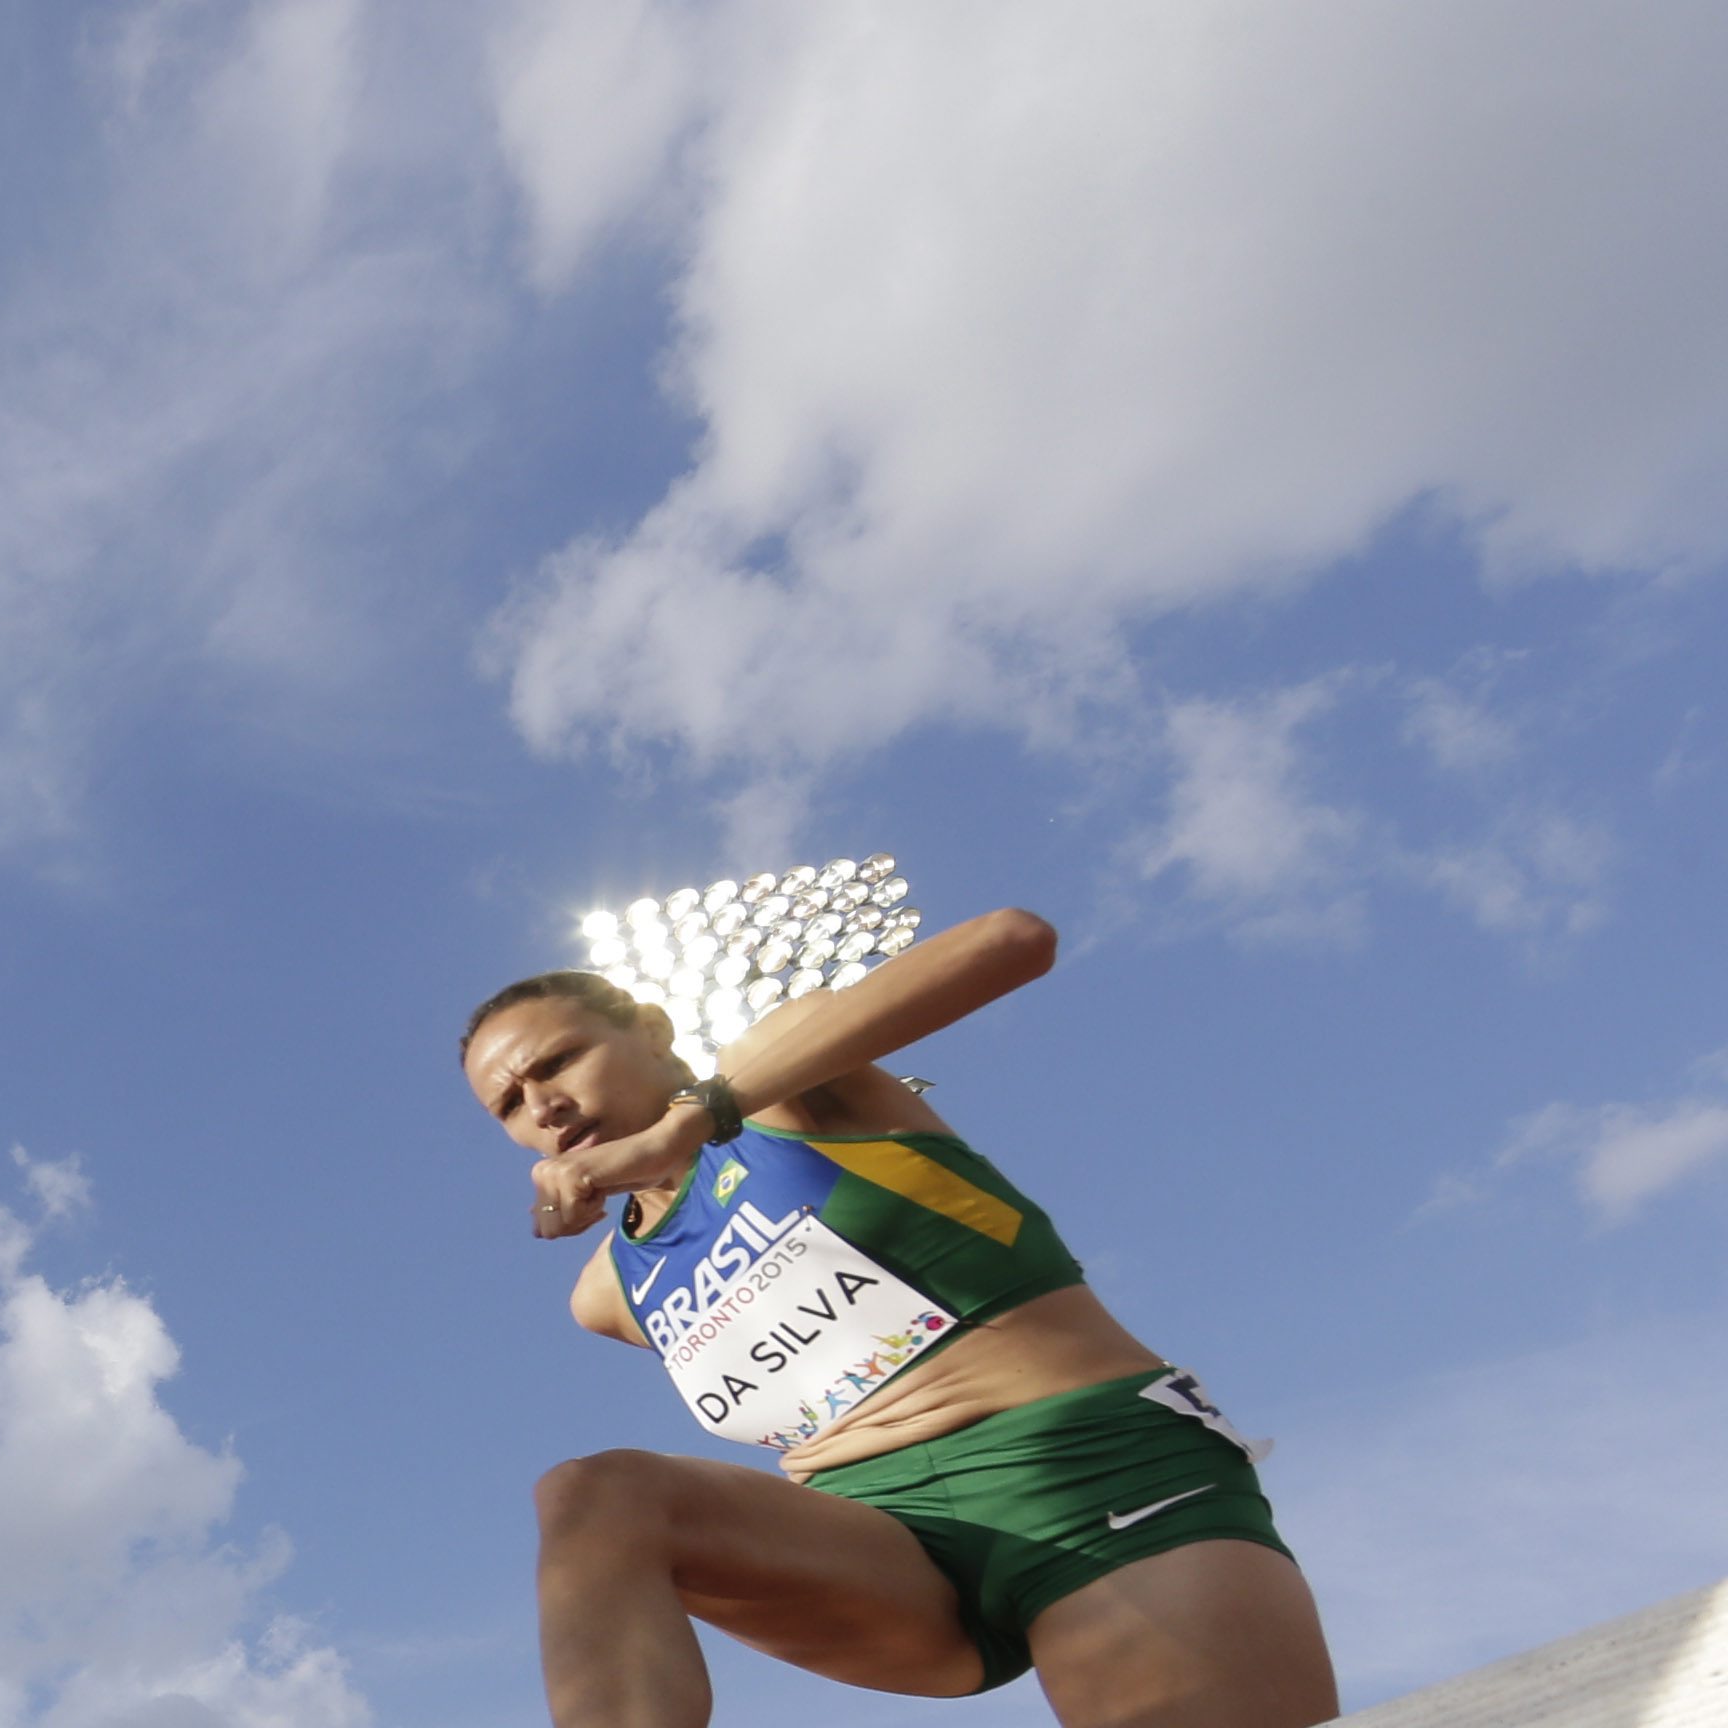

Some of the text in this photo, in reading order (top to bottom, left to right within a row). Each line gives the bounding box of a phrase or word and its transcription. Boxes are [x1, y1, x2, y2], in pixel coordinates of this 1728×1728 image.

[645, 1201, 801, 1352] BRASIL
[696, 1271, 880, 1424] DA SILVA
